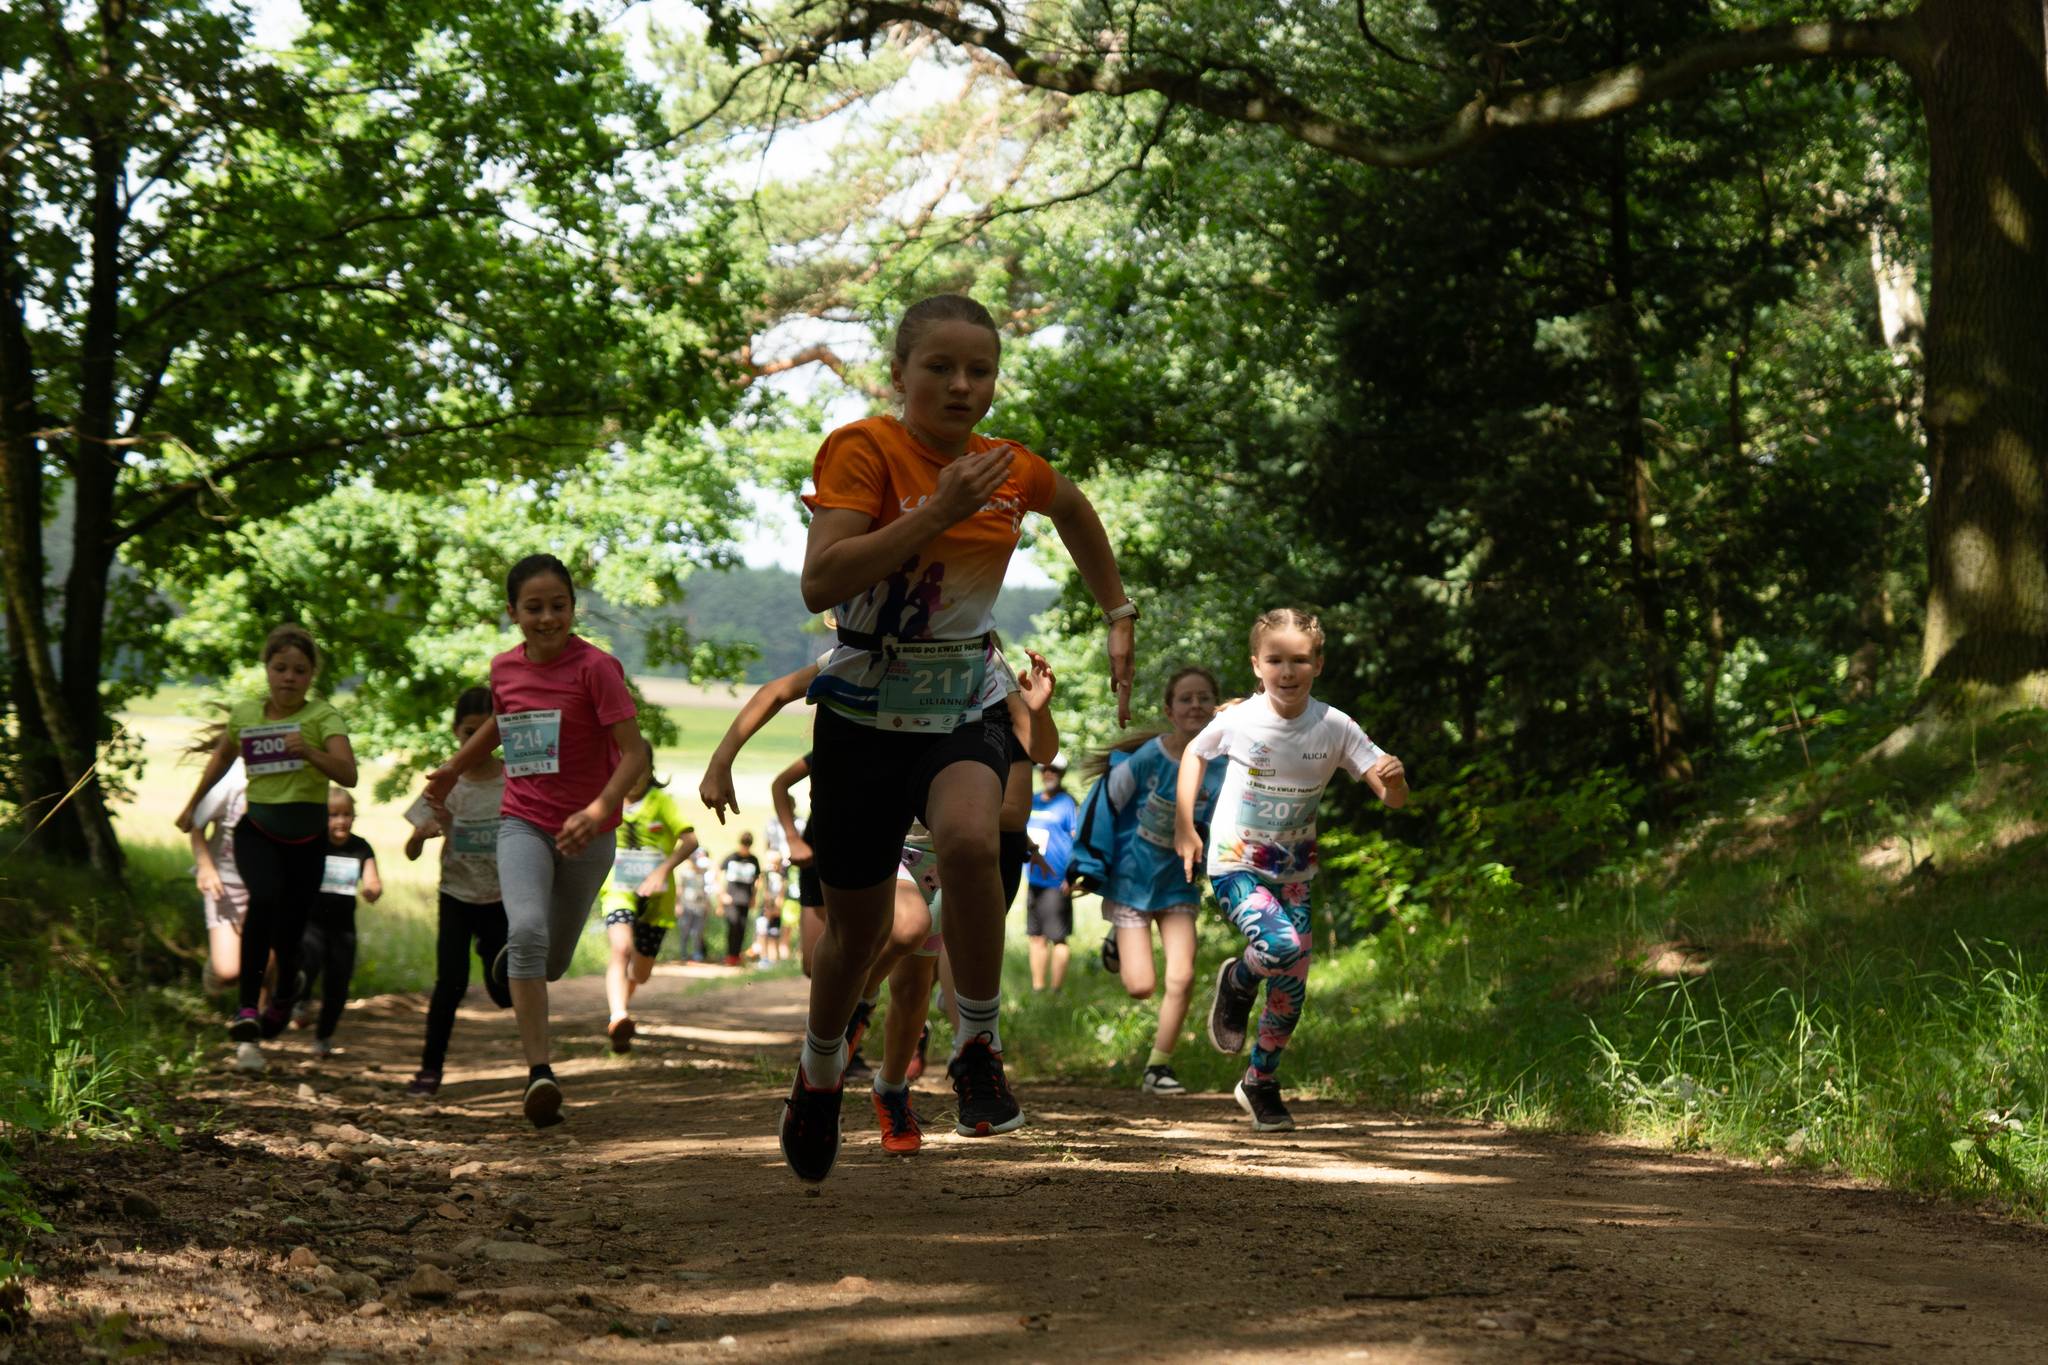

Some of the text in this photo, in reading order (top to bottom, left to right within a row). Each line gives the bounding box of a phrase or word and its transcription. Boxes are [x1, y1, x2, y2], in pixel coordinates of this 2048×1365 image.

[924, 646, 936, 654] PO
[937, 644, 963, 653] KWIAT
[911, 668, 974, 695] 211
[251, 737, 285, 755] 200
[511, 729, 543, 750] 214
[1302, 752, 1328, 760] ALICJA
[1258, 801, 1306, 819] 207
